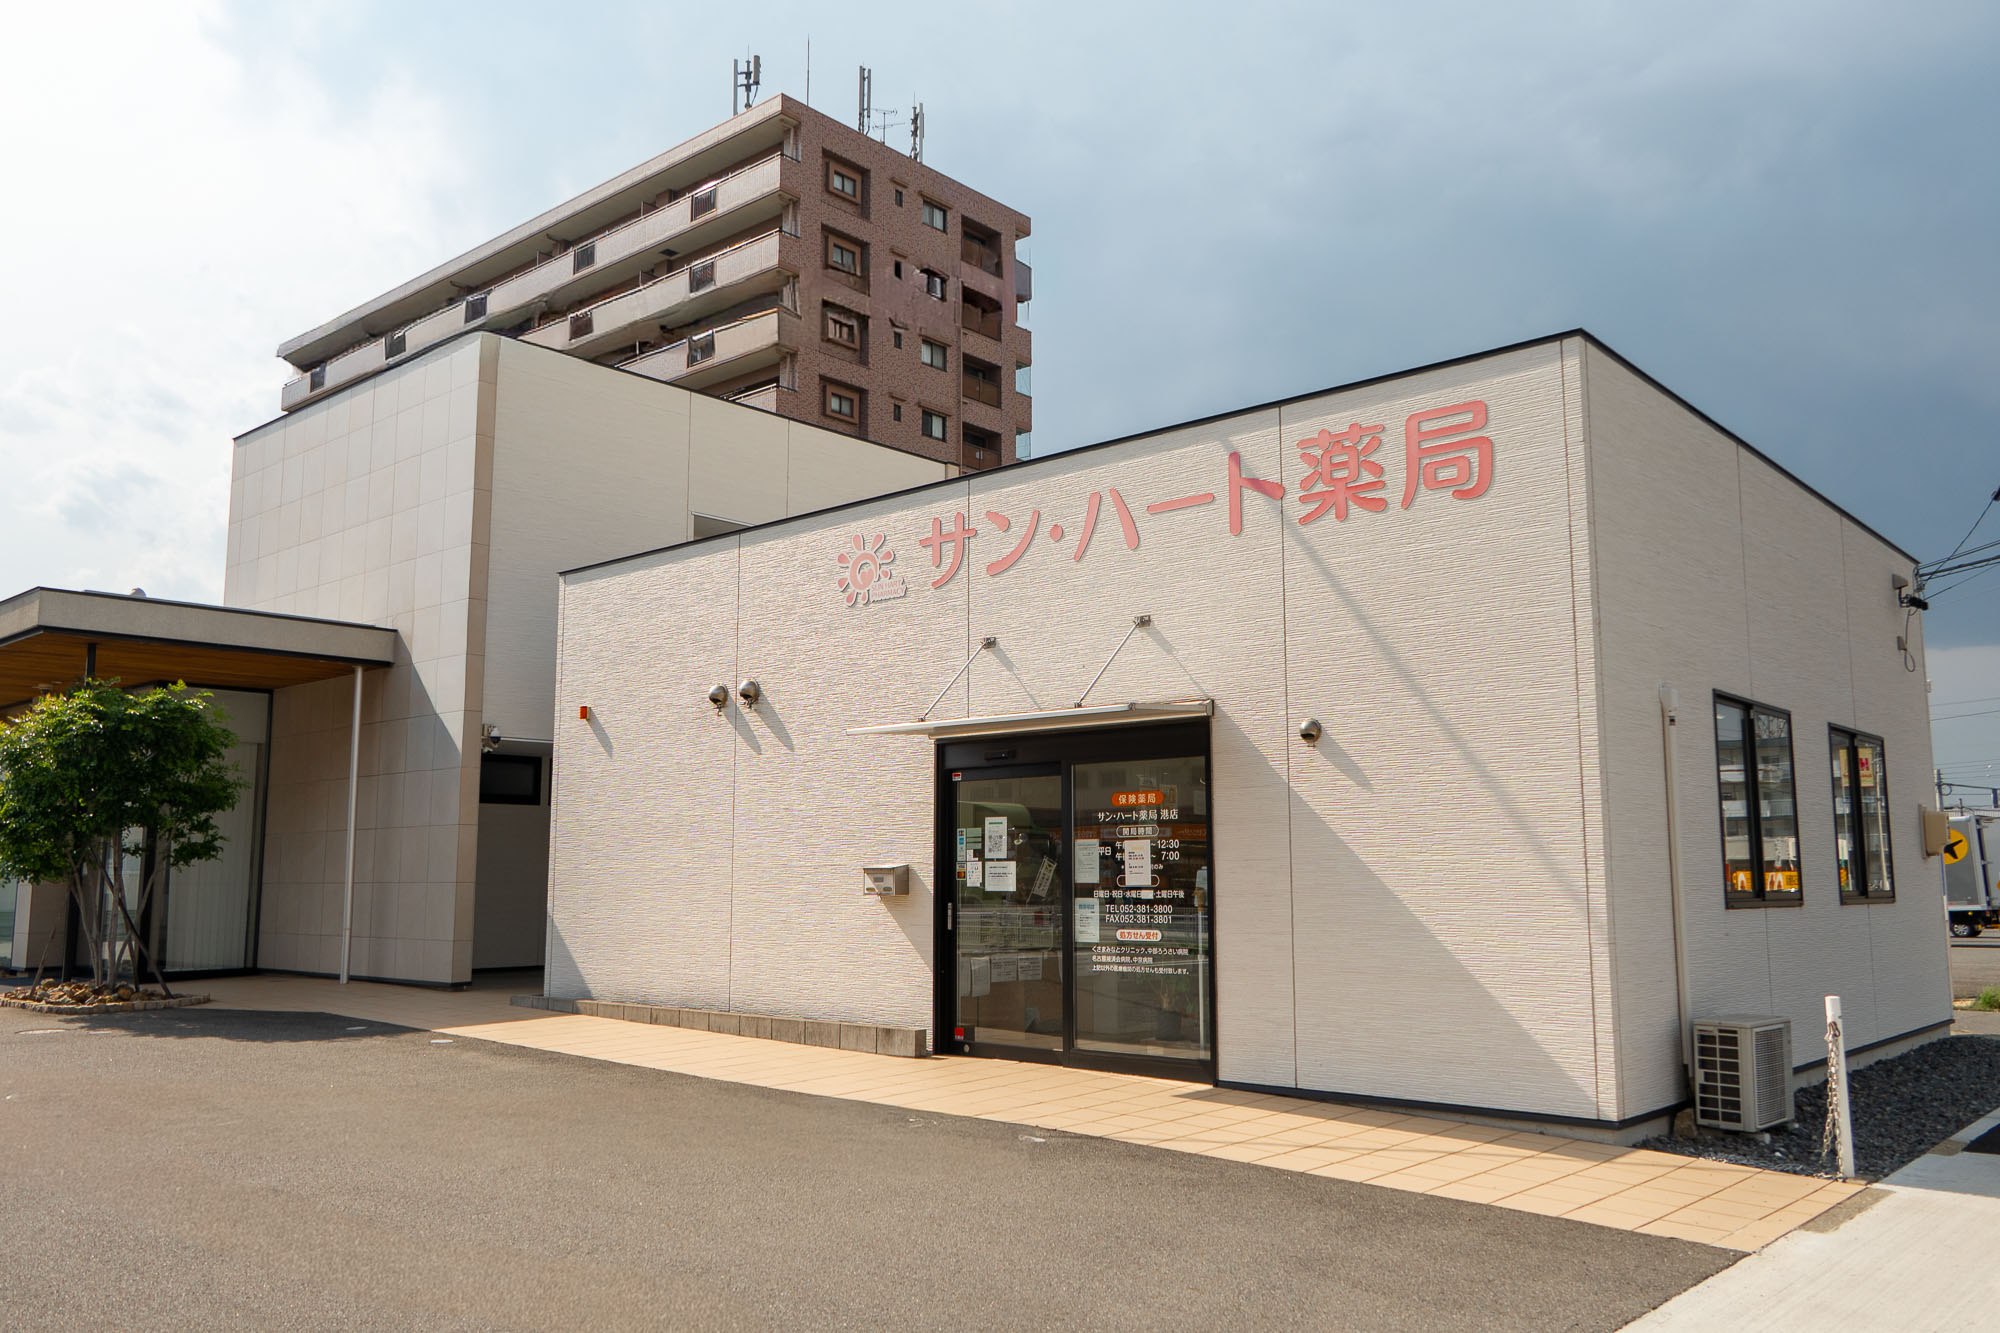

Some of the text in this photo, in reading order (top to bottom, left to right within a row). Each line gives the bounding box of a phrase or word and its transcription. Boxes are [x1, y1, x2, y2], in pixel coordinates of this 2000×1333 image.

[919, 400, 1493, 589] サン・ハート薬局
[1118, 793, 1156, 804] 保険薬局
[1097, 808, 1179, 822] サン・ハート薬局 港店
[1122, 826, 1153, 836] 開局時間
[1097, 846, 1112, 857] 平日
[1160, 850, 1180, 861] 7:00
[1119, 931, 1158, 940] 処方せん受付
